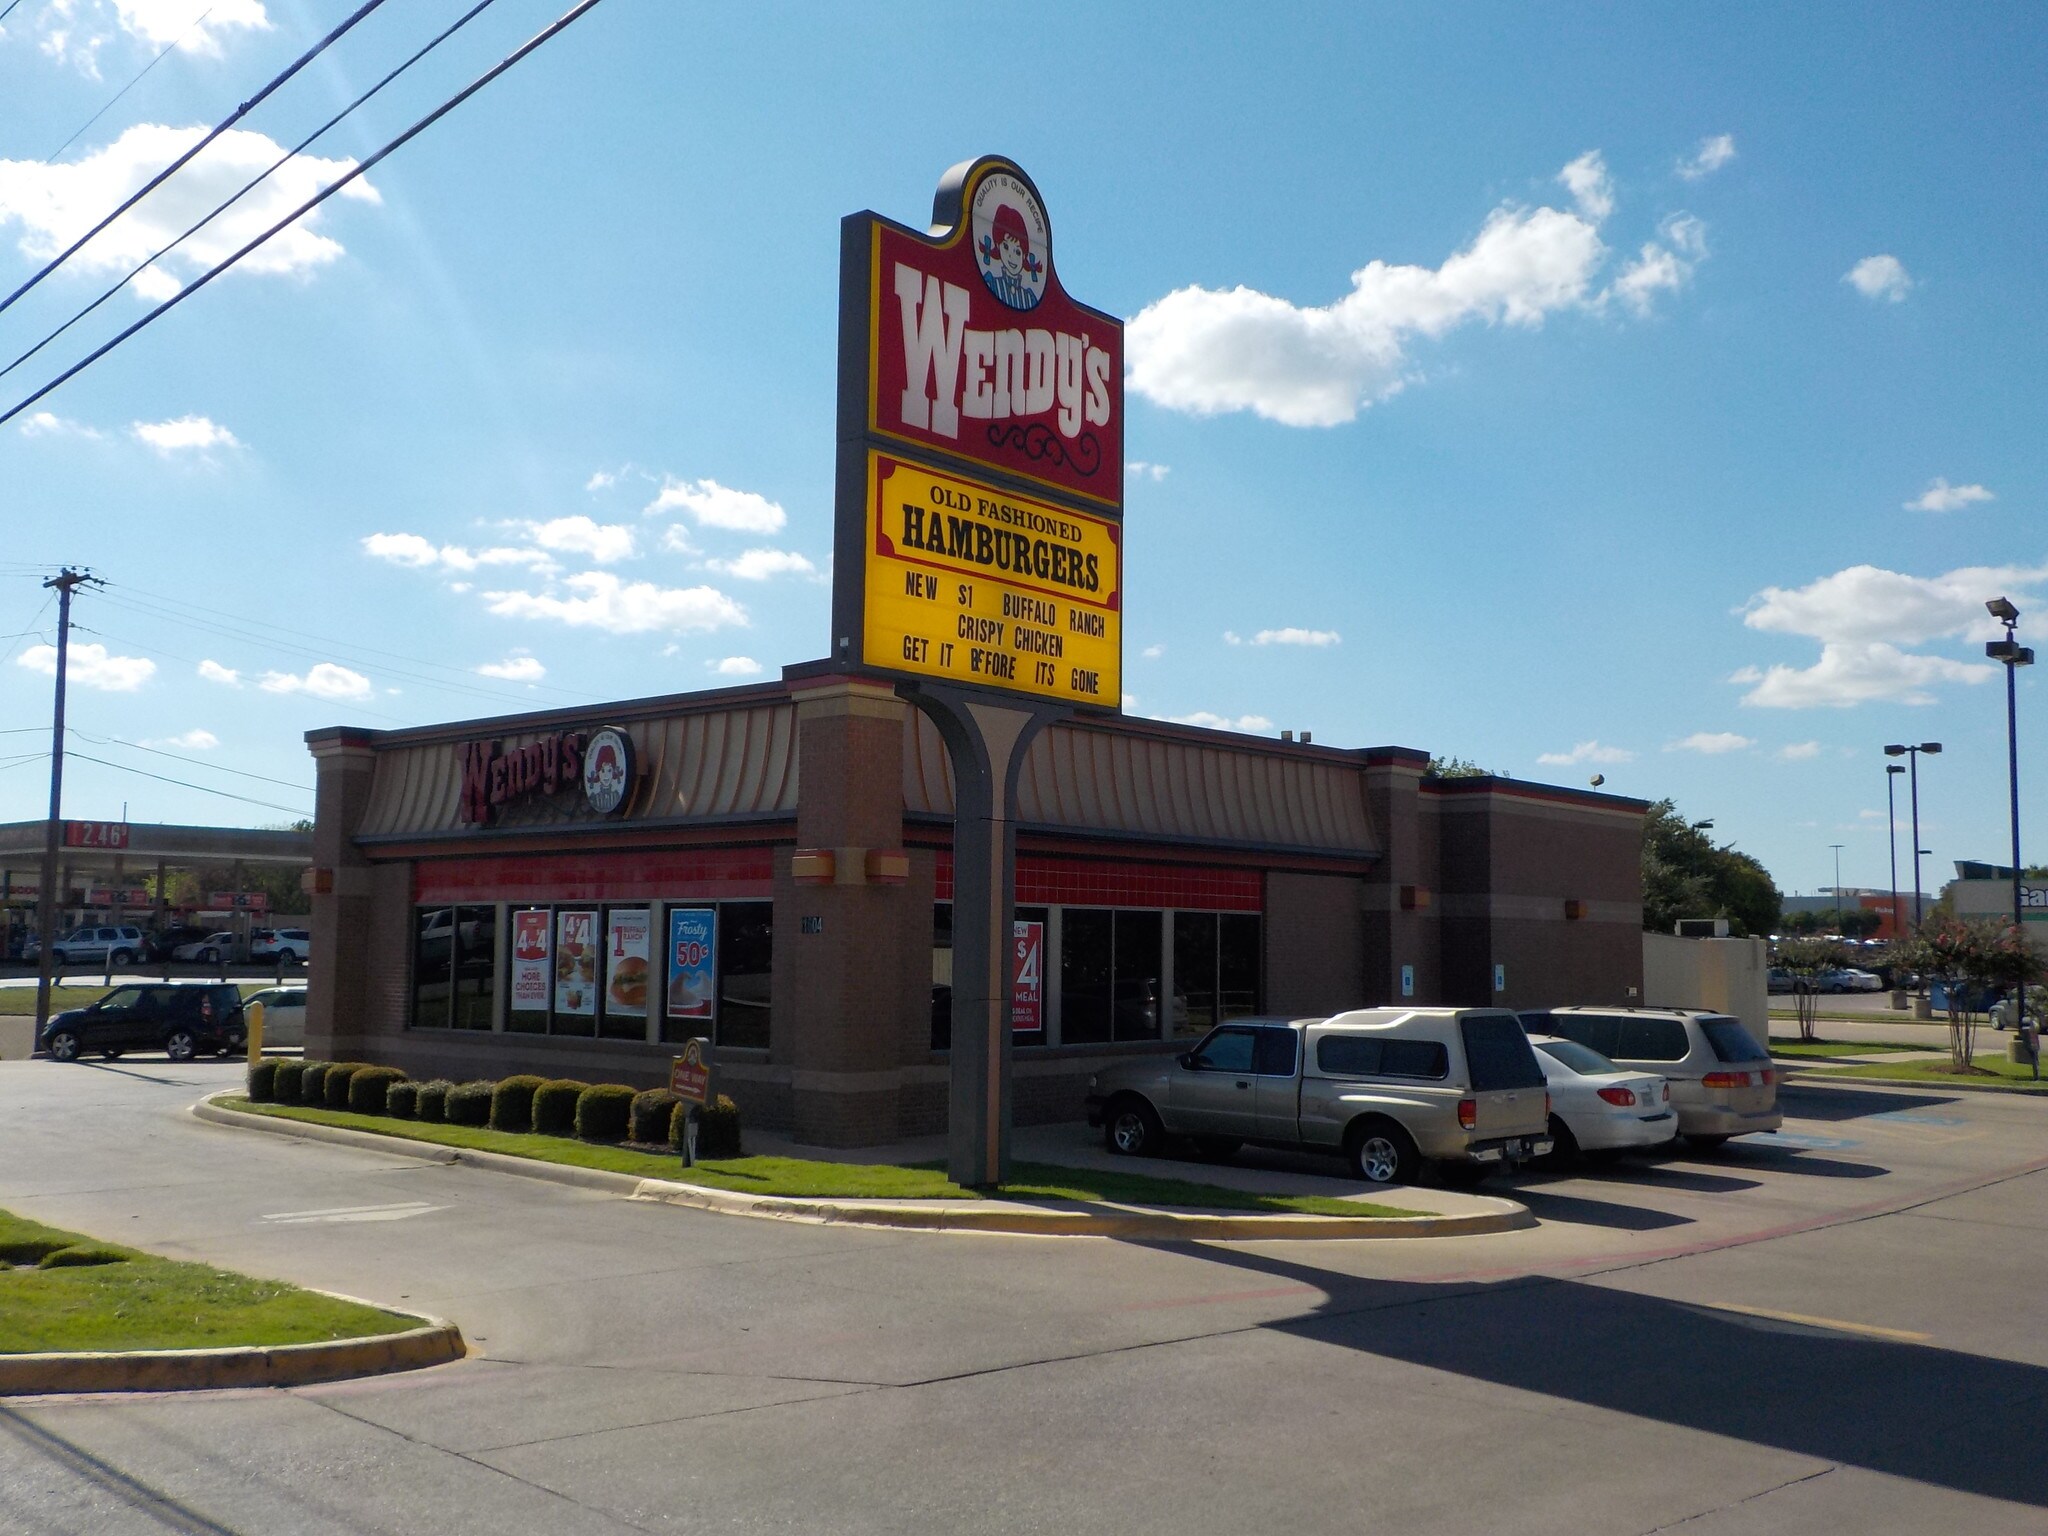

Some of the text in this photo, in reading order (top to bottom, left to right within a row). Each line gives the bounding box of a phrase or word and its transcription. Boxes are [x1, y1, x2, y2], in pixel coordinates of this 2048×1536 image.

[977, 177, 1044, 233] QUALITY IS OUR RECIPE
[930, 486, 1082, 543] OLD FASHIONED
[902, 504, 1099, 592] HAMBURGERS
[906, 571, 937, 601] NEW
[1003, 593, 1056, 627] BUFFALO
[1069, 608, 1105, 638] RANCH
[958, 614, 1063, 658] CRISPY CHICKEN
[903, 635, 929, 663] GET
[940, 643, 954, 668] IT
[1035, 661, 1055, 687] ITS
[1071, 668, 1099, 695] GONE
[517, 929, 528, 952] 4
[677, 920, 708, 941] Frosty
[515, 982, 546, 991] CHOICES
[521, 972, 541, 981] MORE
[1015, 992, 1038, 1002] MEAL
[674, 1068, 706, 1085] ONE WAY
